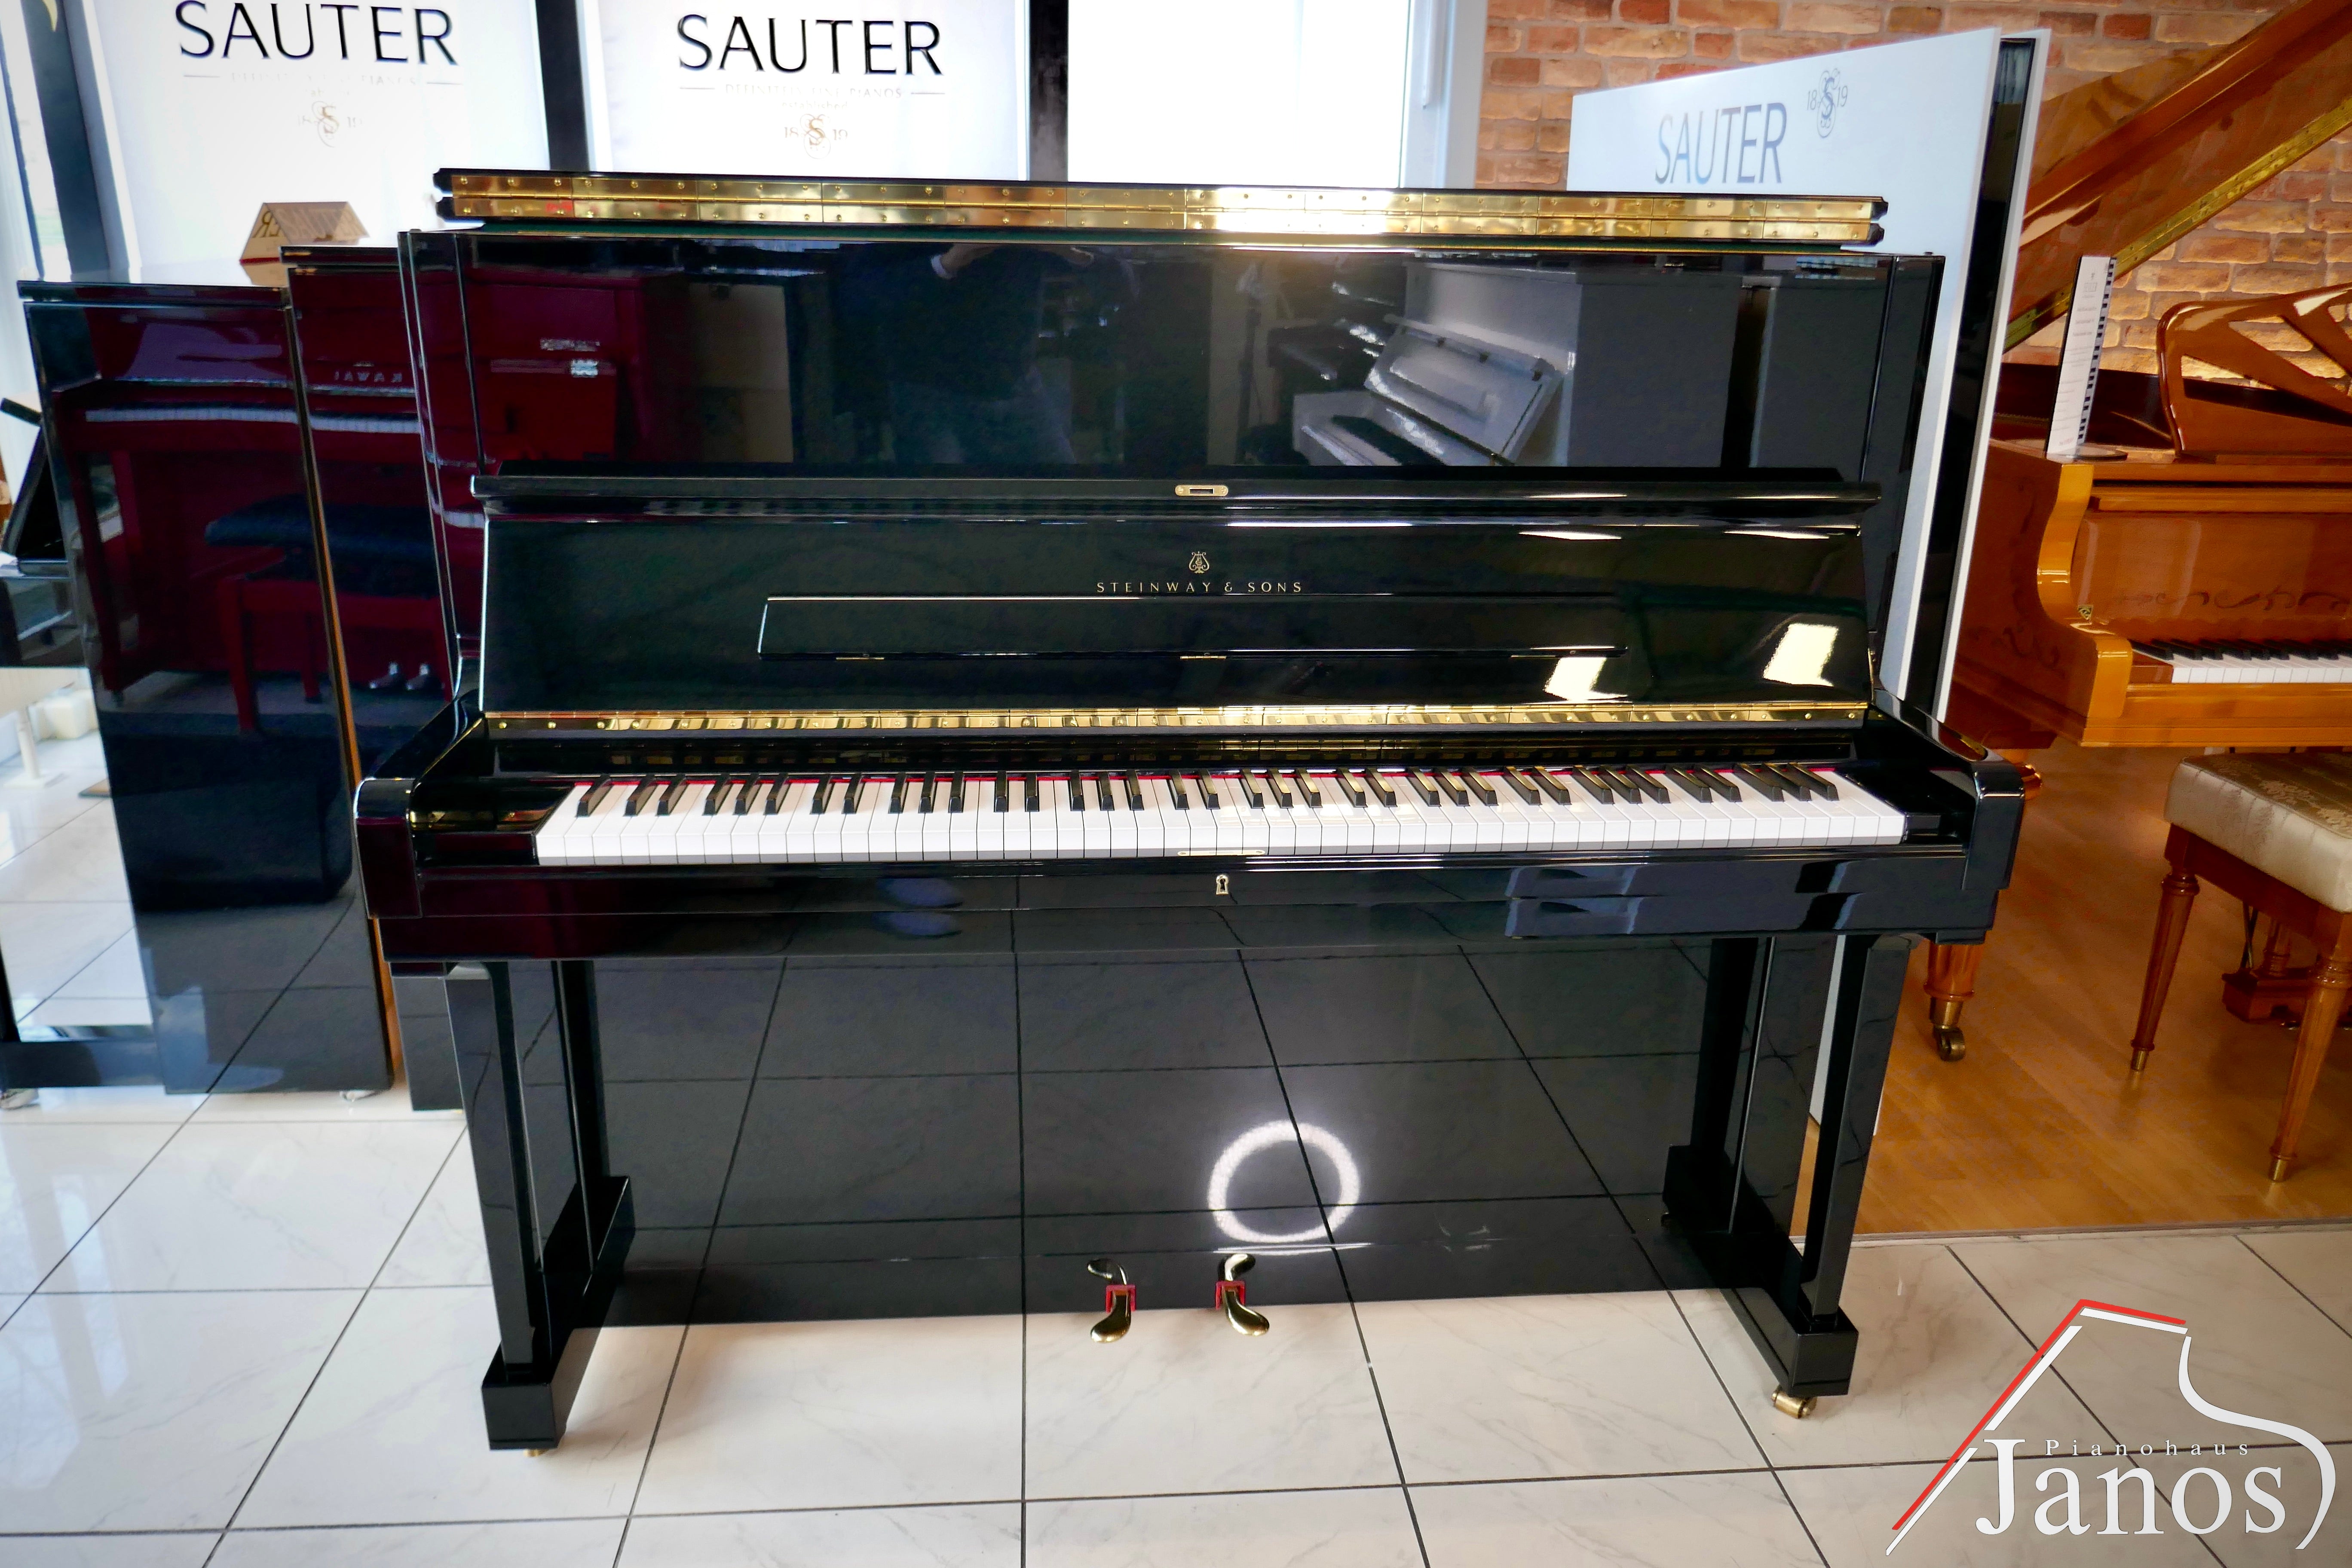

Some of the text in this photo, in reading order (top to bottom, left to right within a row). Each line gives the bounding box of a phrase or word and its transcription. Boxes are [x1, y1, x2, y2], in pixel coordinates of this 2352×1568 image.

[175, 0, 459, 65] SAUTER
[678, 14, 943, 76] SAUTER
[850, 88, 901, 98] PIANOS
[1655, 102, 1787, 184] SAUTER
[1097, 582, 1302, 593] STEINWAY & SONS
